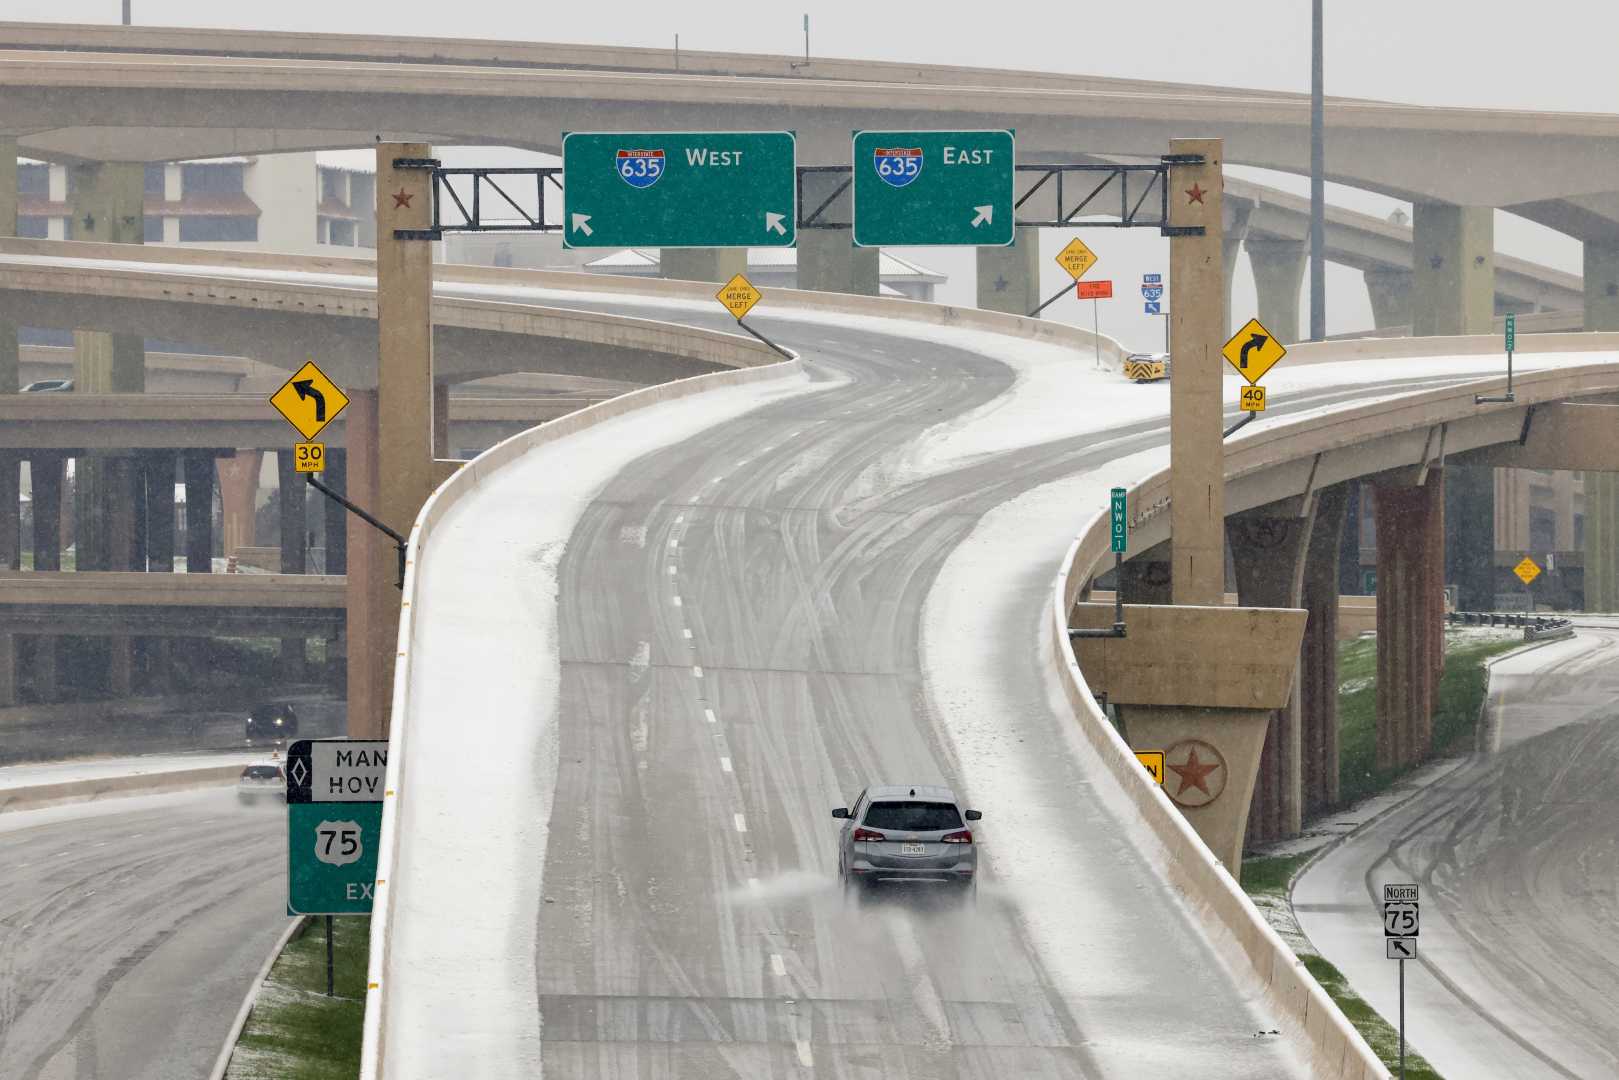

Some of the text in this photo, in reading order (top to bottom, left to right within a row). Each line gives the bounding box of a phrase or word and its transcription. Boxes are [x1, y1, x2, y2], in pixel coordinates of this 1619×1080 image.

[685, 148, 743, 166] WEST
[943, 146, 993, 164] EAST
[621, 158, 660, 177] 635
[879, 157, 918, 176] 635
[726, 292, 752, 300] MERGE
[1144, 288, 1161, 298] 635
[1243, 389, 1263, 401] 40
[298, 446, 322, 460] 30
[336, 750, 387, 767] MAN
[329, 776, 379, 794] HOV
[319, 830, 358, 855] 75
[346, 883, 374, 900] EX
[1386, 887, 1417, 898] NORTH
[1387, 910, 1415, 929] 75
